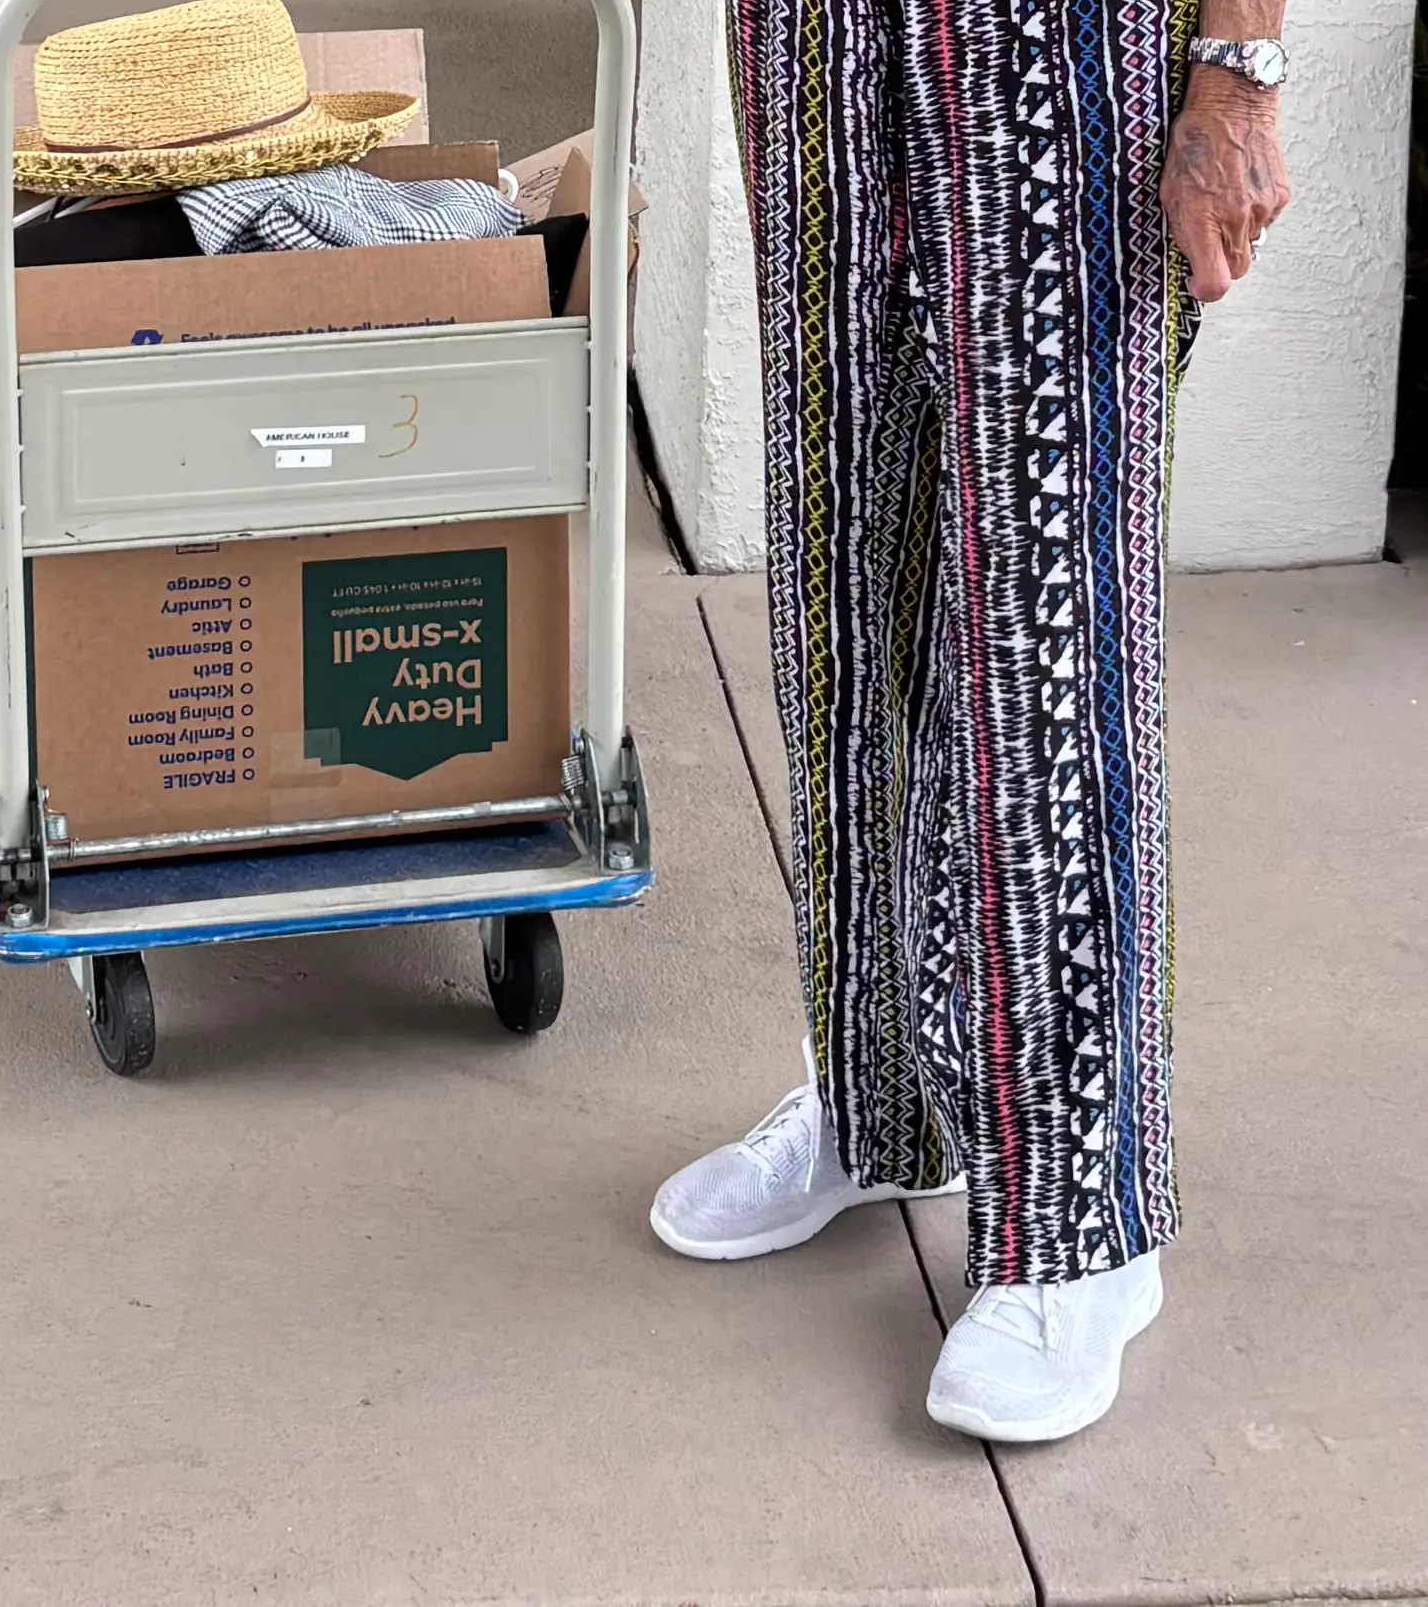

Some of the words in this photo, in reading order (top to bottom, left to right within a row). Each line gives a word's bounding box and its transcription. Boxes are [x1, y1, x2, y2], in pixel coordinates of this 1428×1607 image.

[378, 393, 419, 459] 3
[265, 432, 316, 442] AMERICAN
[316, 430, 350, 440] HOUSE
[166, 576, 232, 592] Garage
[160, 597, 232, 615] Laundry
[191, 619, 233, 635] Attic
[147, 641, 234, 660] Basement
[333, 619, 482, 664] x-small
[193, 662, 234, 679] Bath
[392, 658, 482, 690] Duty
[168, 684, 235, 701] Kitchen
[128, 710, 177, 725] Room
[179, 705, 236, 723] Dining
[362, 694, 482, 727] Heavy
[127, 732, 176, 747] Room
[179, 726, 236, 745] Family
[159, 747, 236, 765] Bedroom
[163, 769, 237, 790] FRAGILE
